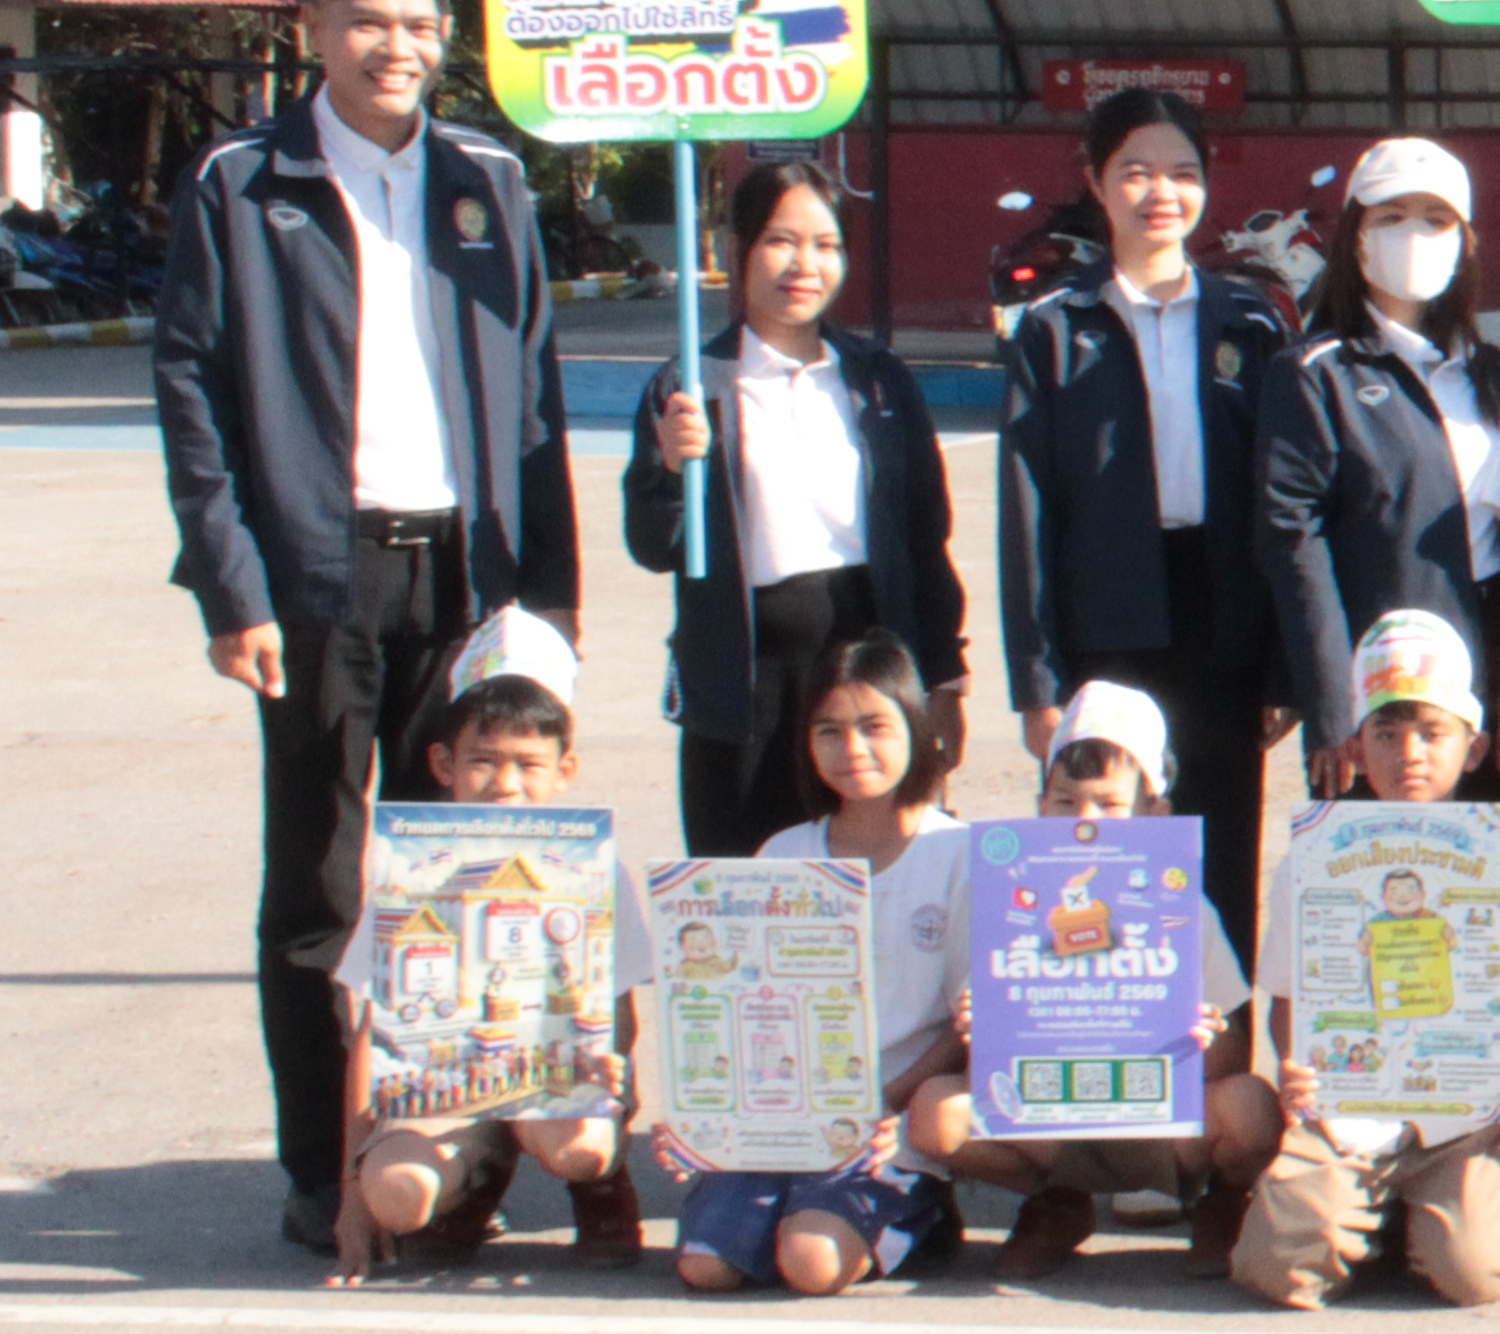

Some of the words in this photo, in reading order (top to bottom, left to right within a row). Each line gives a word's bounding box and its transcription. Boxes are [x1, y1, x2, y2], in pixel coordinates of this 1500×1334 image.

[552, 26, 819, 107] เลือกตั้ง
[991, 923, 1180, 979] เลือกตั้ง
[1007, 985, 1022, 1002] 8
[1118, 983, 1169, 1001] 2569
